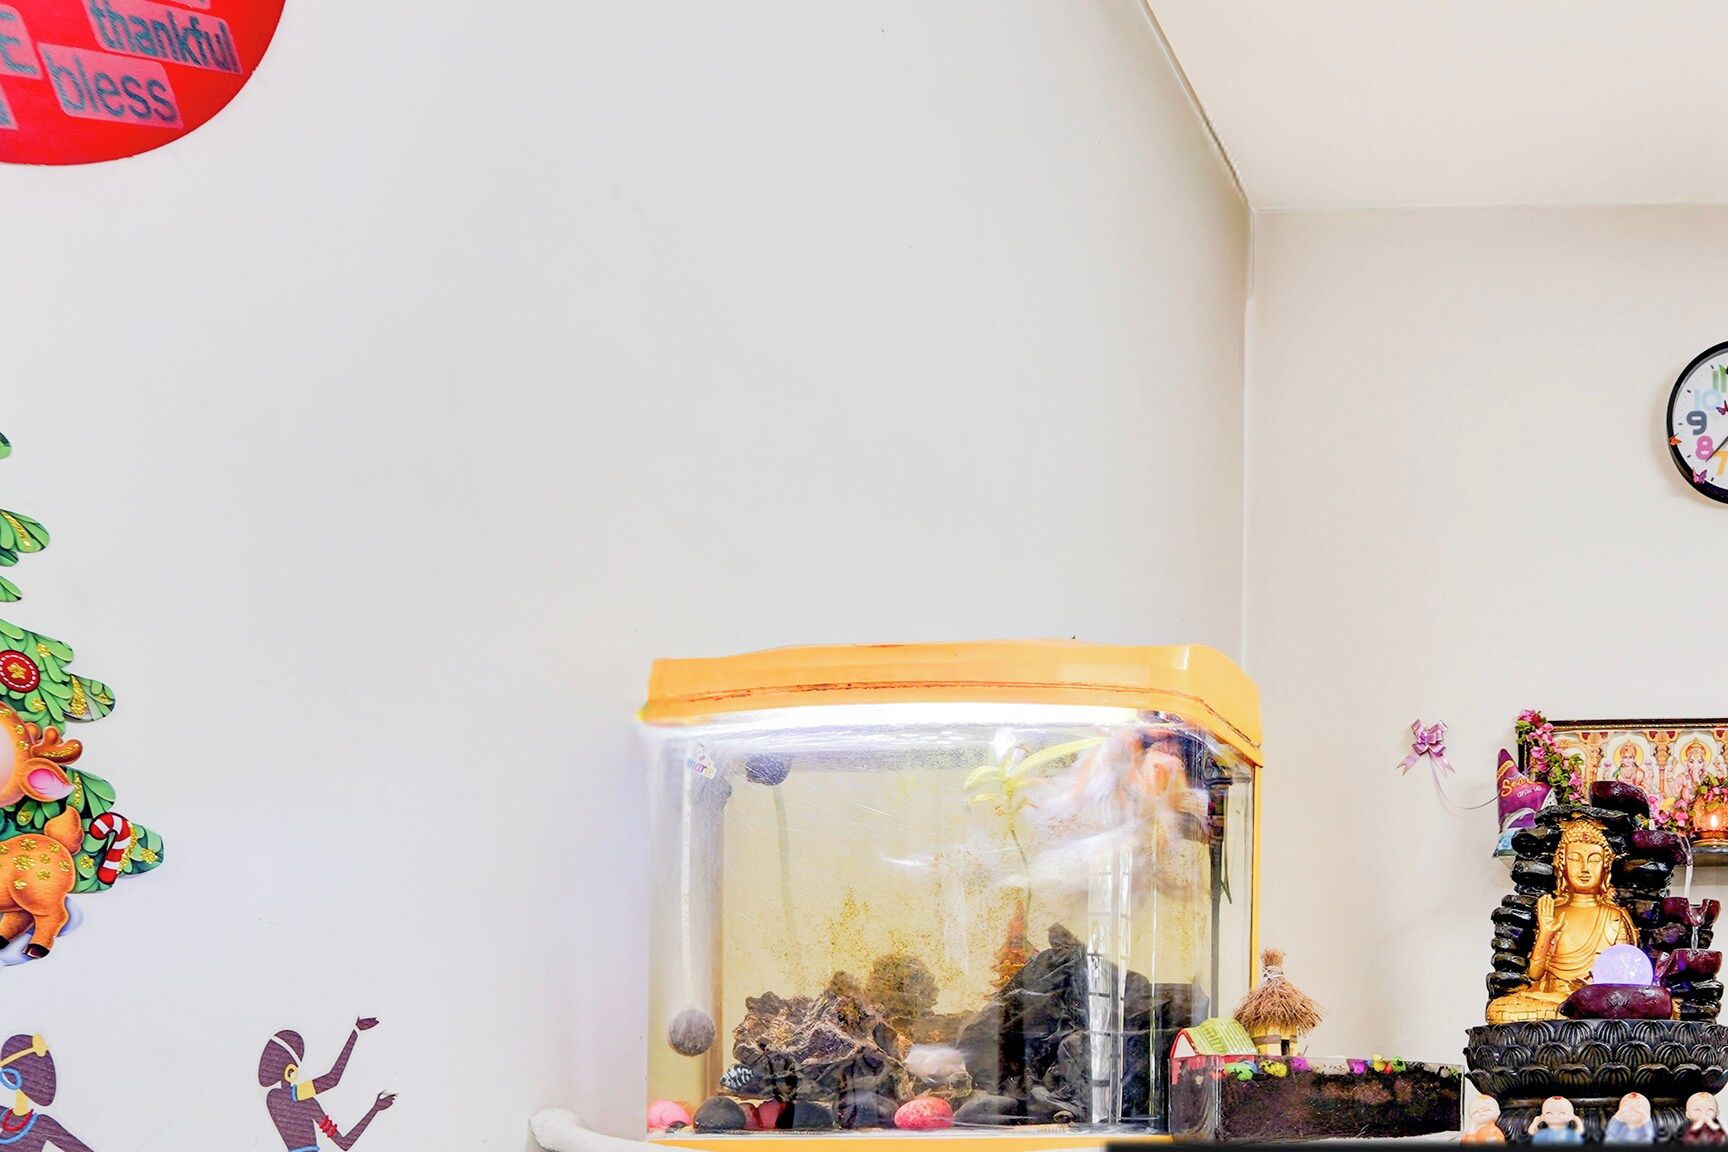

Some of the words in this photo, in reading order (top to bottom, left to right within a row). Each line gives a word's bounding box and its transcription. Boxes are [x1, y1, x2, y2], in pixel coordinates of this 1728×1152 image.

[88, 0, 241, 73] thankful
[43, 48, 178, 123] bless
[1686, 410, 1708, 436] 9
[1695, 435, 1713, 460] 8
